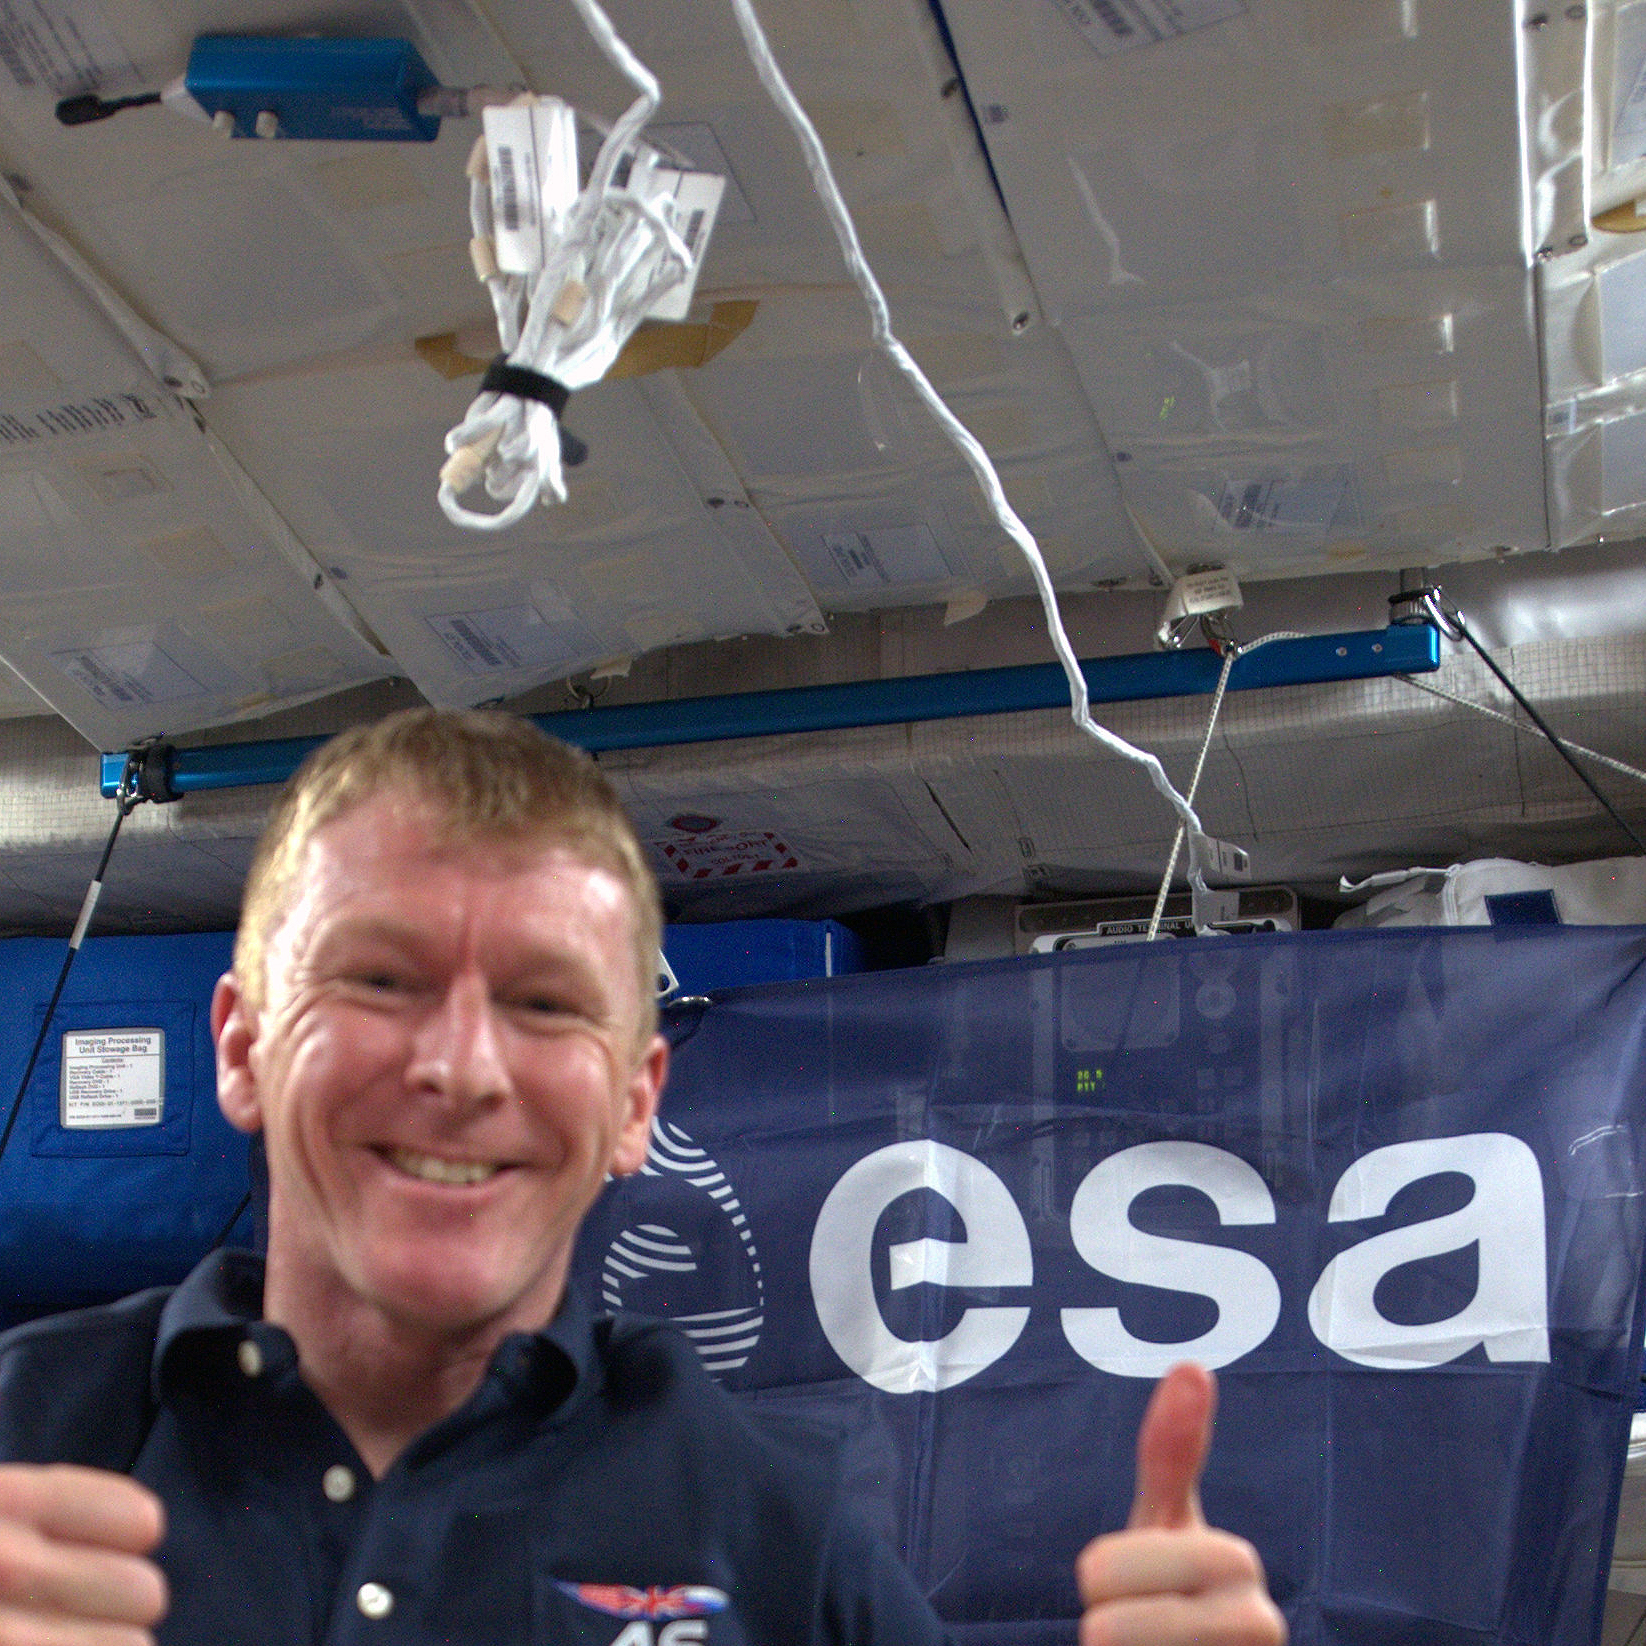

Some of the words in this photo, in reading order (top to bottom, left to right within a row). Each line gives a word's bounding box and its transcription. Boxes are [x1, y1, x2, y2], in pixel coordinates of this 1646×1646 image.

[1107, 925, 1133, 934] AUDIO
[75, 1038, 106, 1046] Imaging
[108, 1036, 151, 1044] Processing
[809, 1132, 1550, 1394] esa
